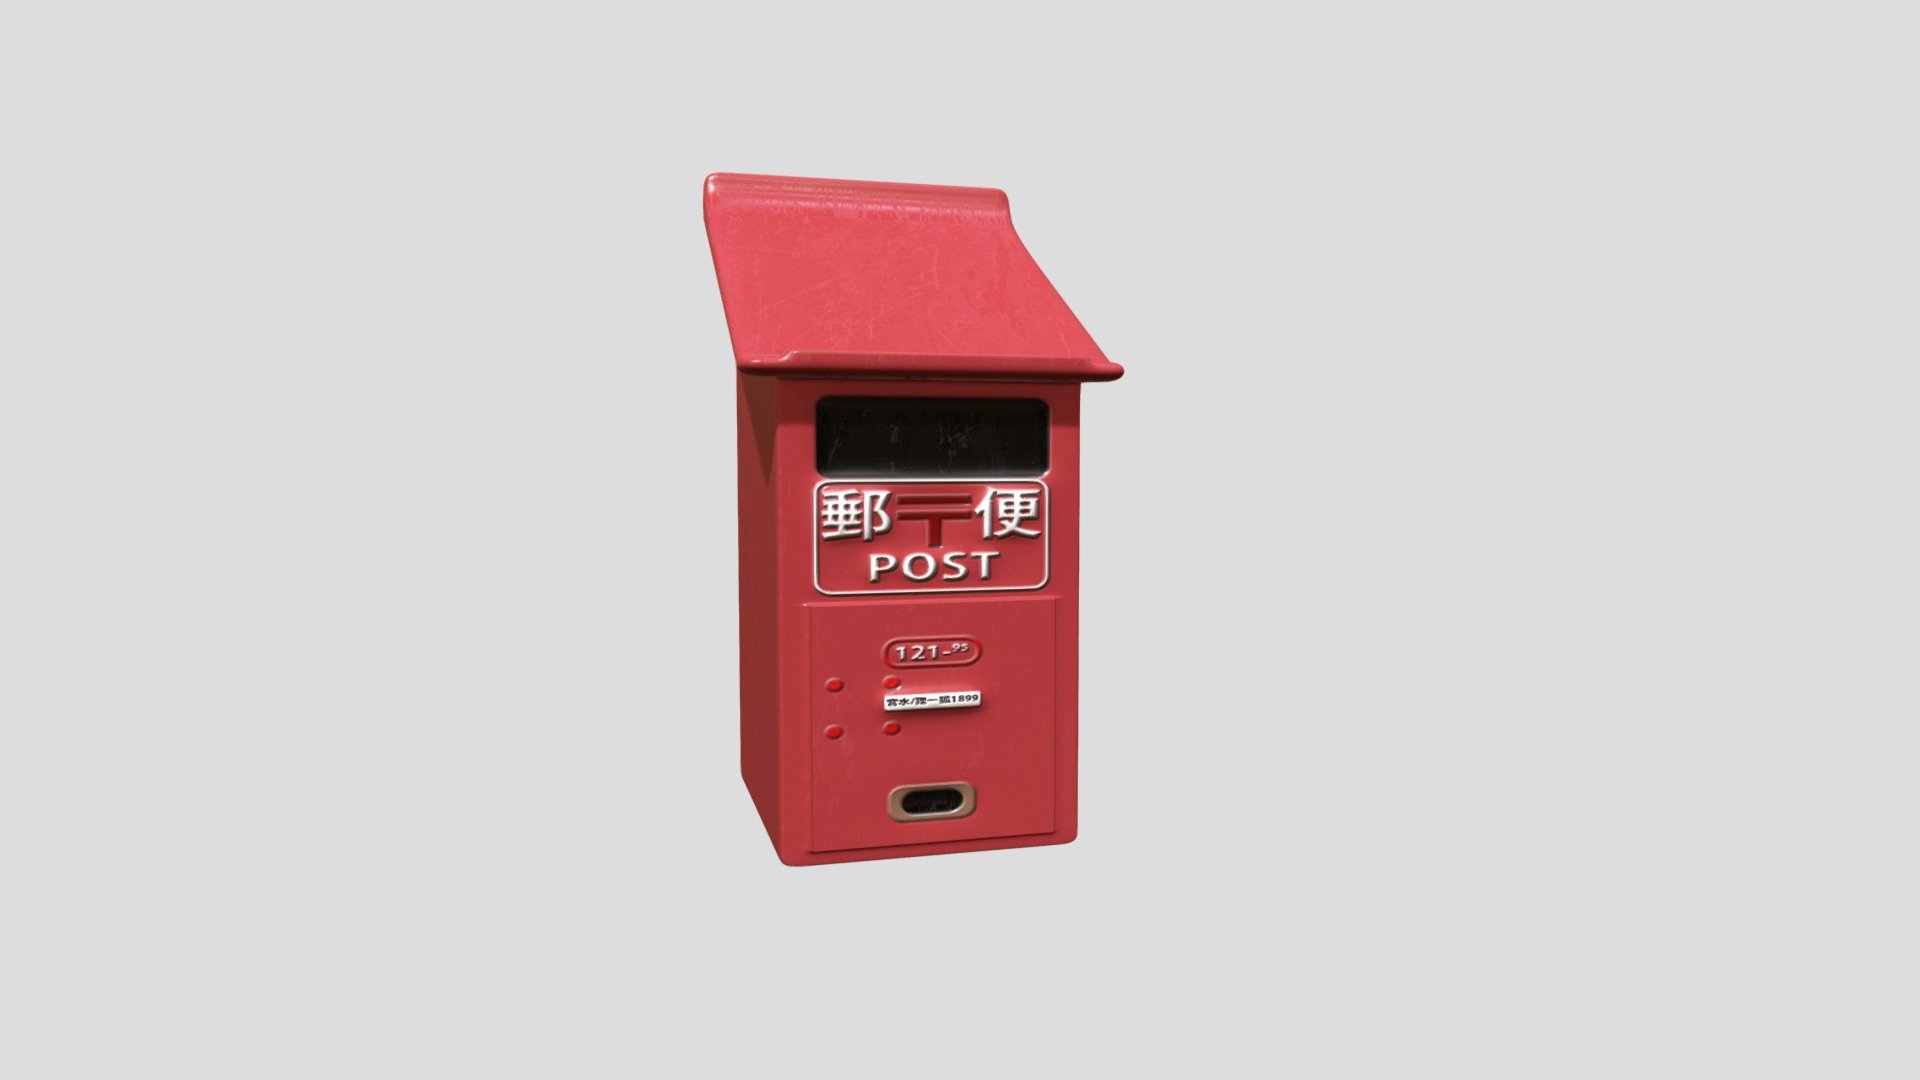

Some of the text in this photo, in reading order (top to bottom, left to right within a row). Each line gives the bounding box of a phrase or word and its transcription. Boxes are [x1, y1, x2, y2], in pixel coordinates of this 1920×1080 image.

[821, 486, 1042, 542] 郵 便
[869, 551, 1000, 583] POST
